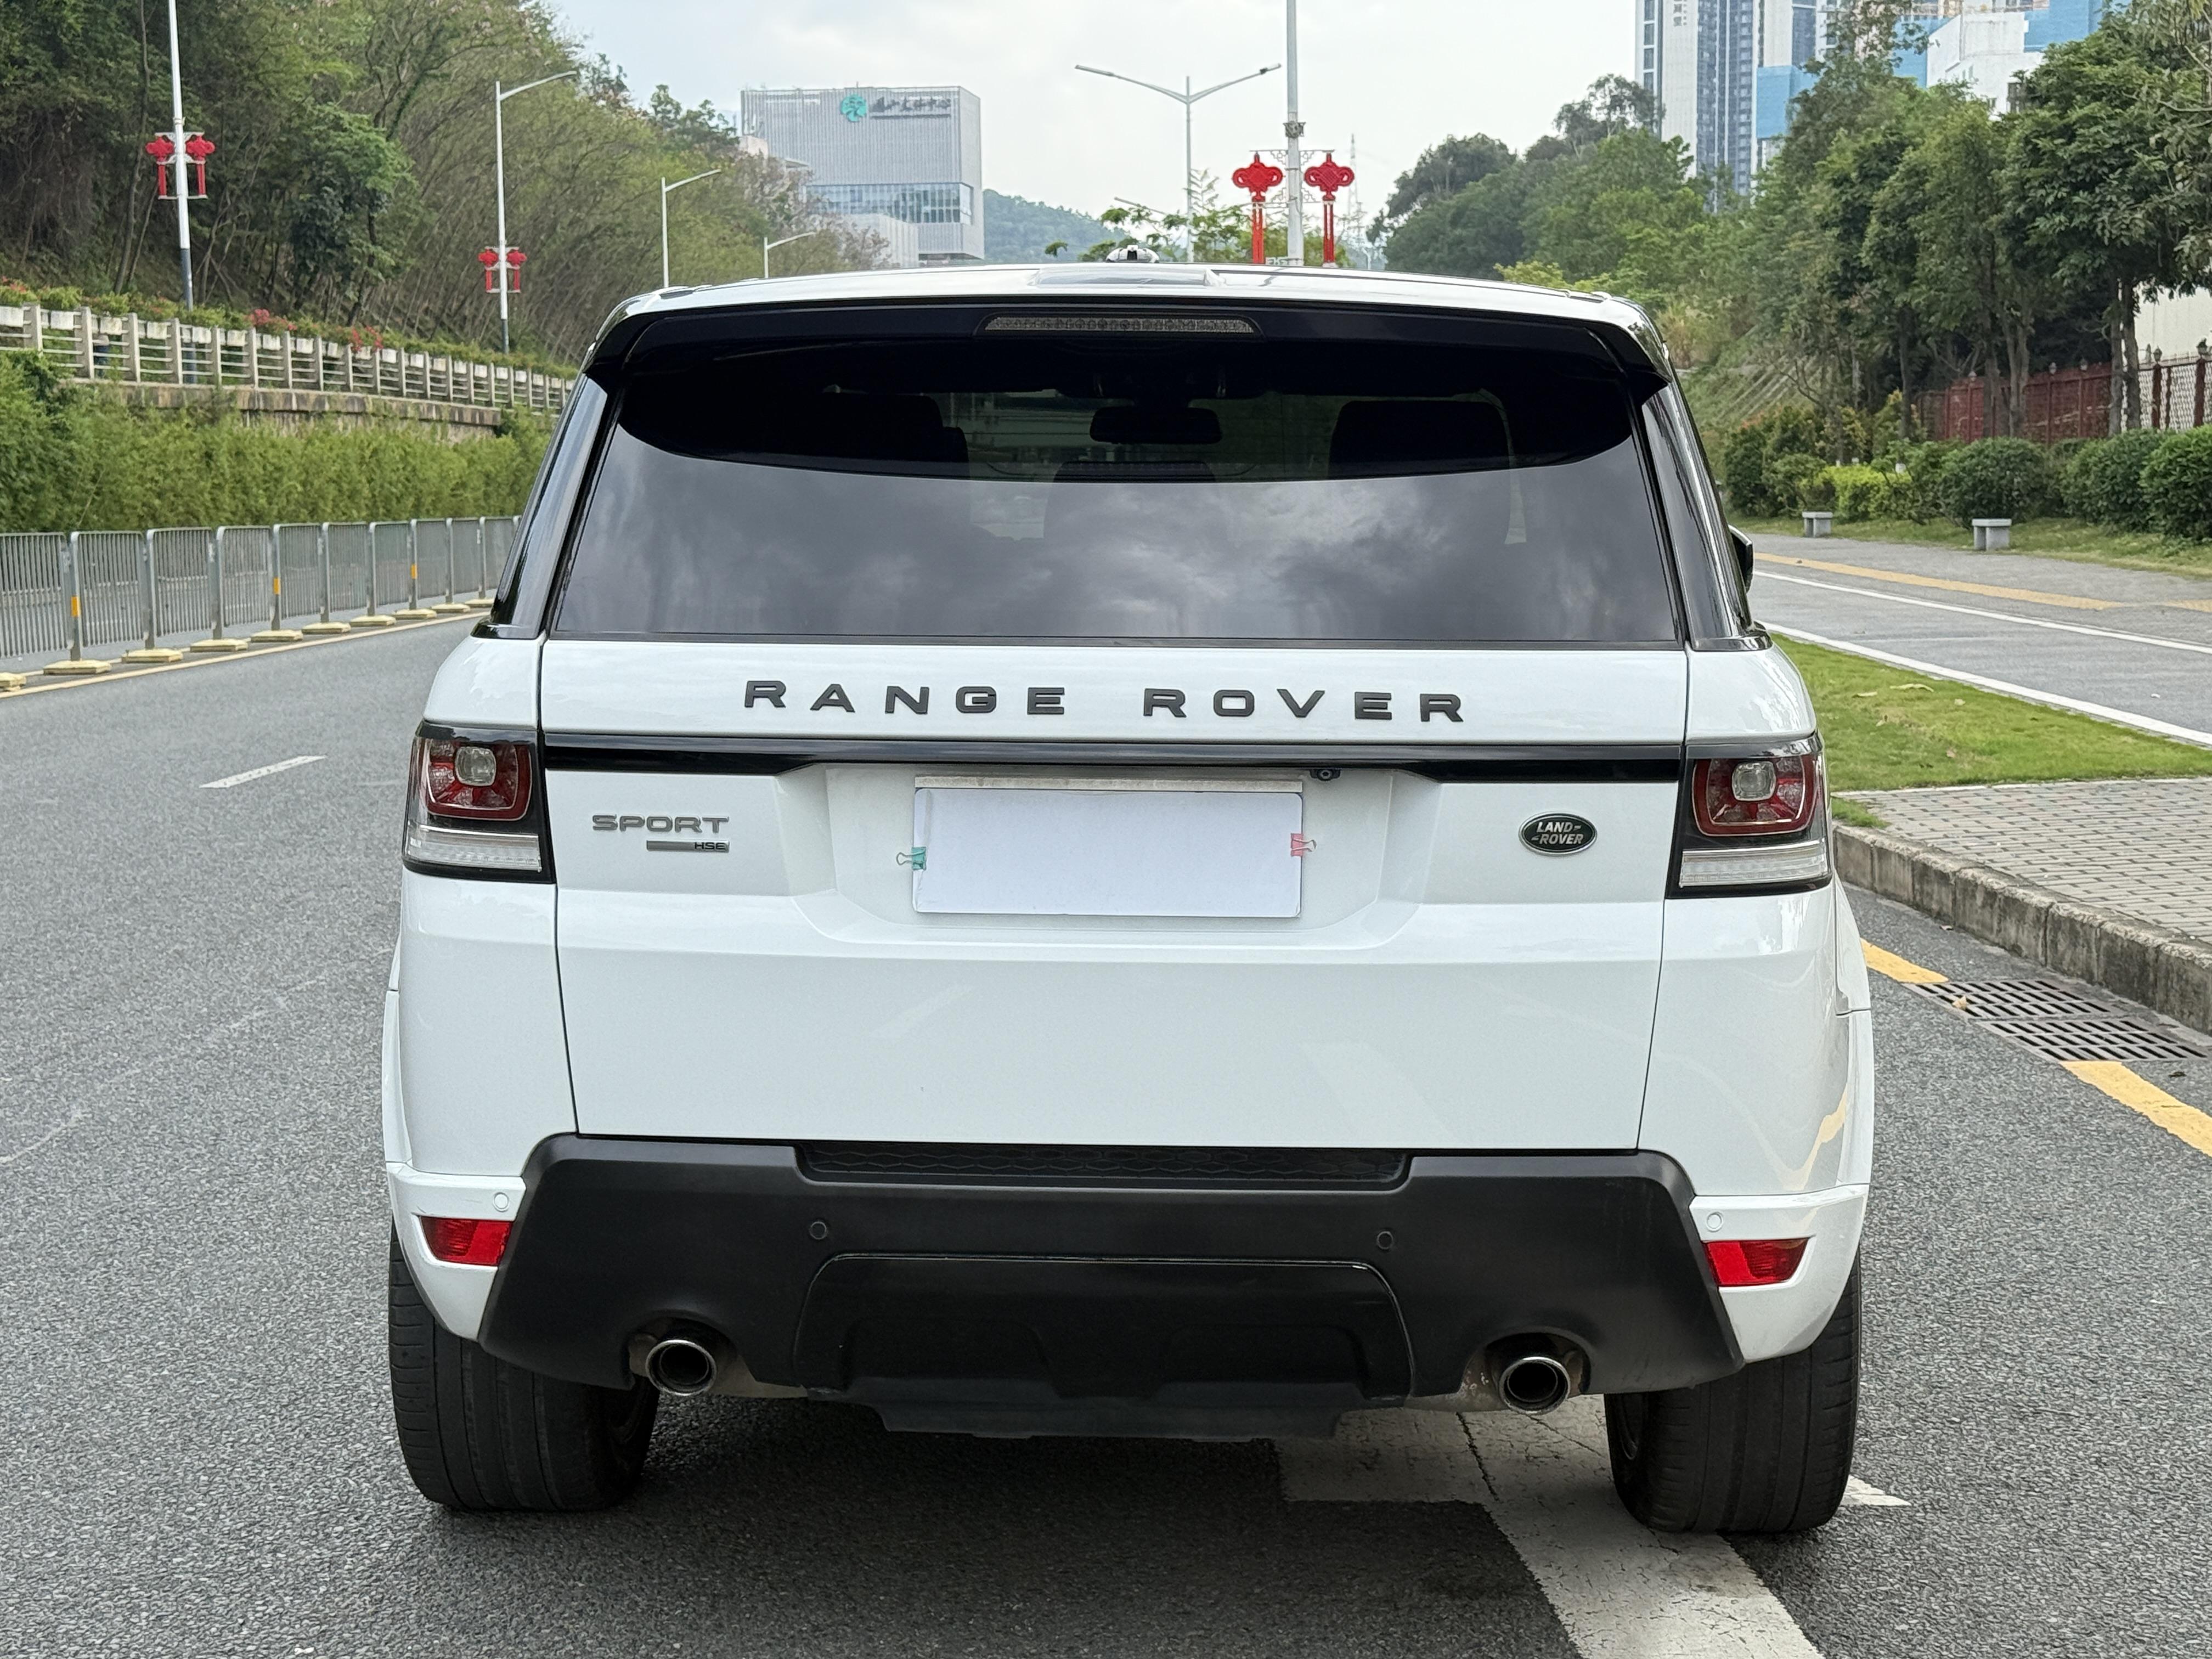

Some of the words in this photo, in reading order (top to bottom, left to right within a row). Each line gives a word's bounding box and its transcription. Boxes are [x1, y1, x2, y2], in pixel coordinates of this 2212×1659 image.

[744, 680, 1065, 715] RANGE
[1143, 688, 1464, 723] ROVER
[592, 814, 730, 833] SPORT
[694, 842, 727, 850] HSE
